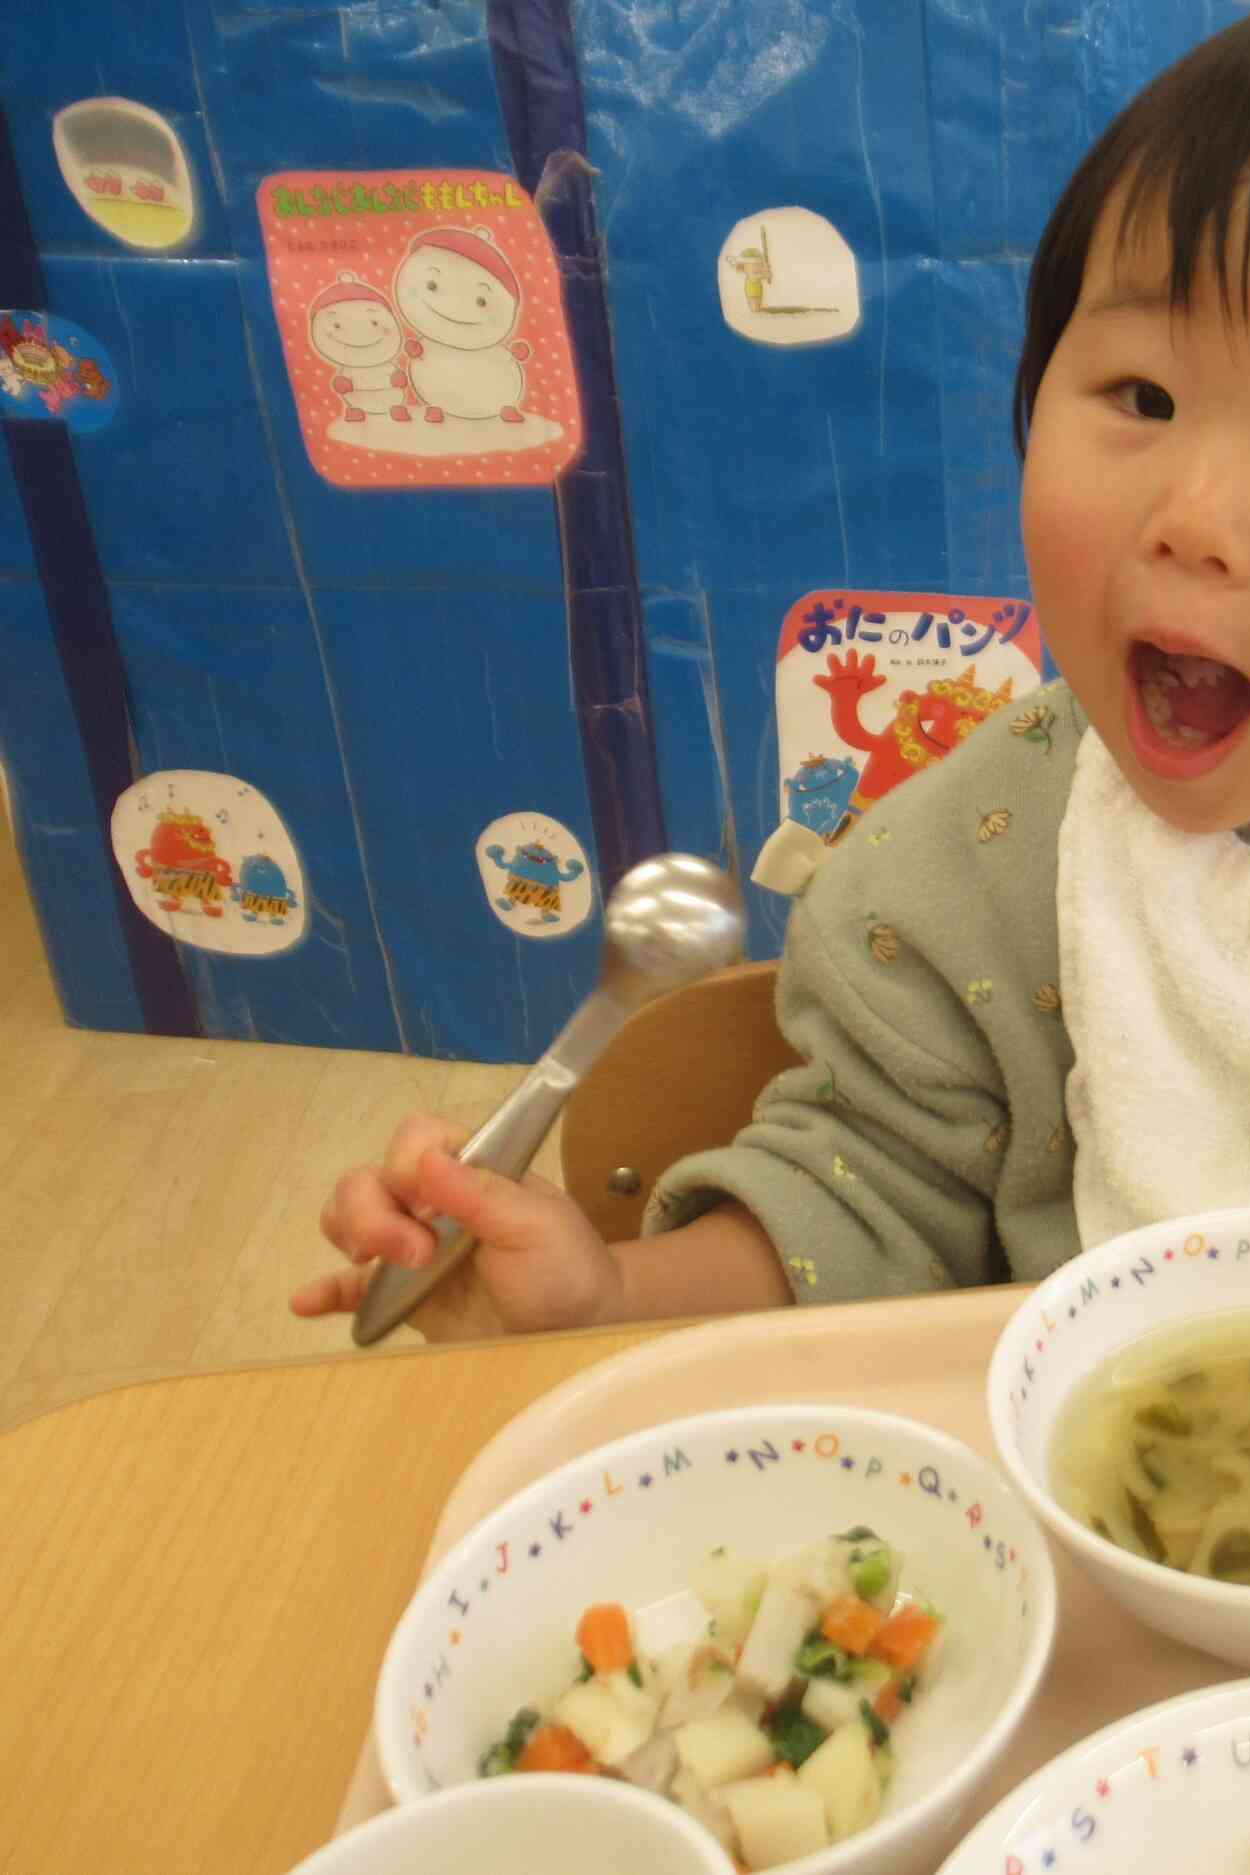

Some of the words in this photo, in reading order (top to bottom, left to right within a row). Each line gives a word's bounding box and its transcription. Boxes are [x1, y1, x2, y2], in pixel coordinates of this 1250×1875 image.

[797, 598, 1030, 657] おにのパンツ
[1131, 1256, 1155, 1286] N
[1183, 1232, 1206, 1257] O
[1235, 1238, 1250, 1261] P
[603, 1470, 624, 1497] L
[663, 1446, 693, 1477] M
[747, 1438, 780, 1473] N
[814, 1432, 840, 1458] O
[917, 1466, 943, 1500] Q
[1071, 1806, 1096, 1841] S
[1137, 1745, 1162, 1778] T
